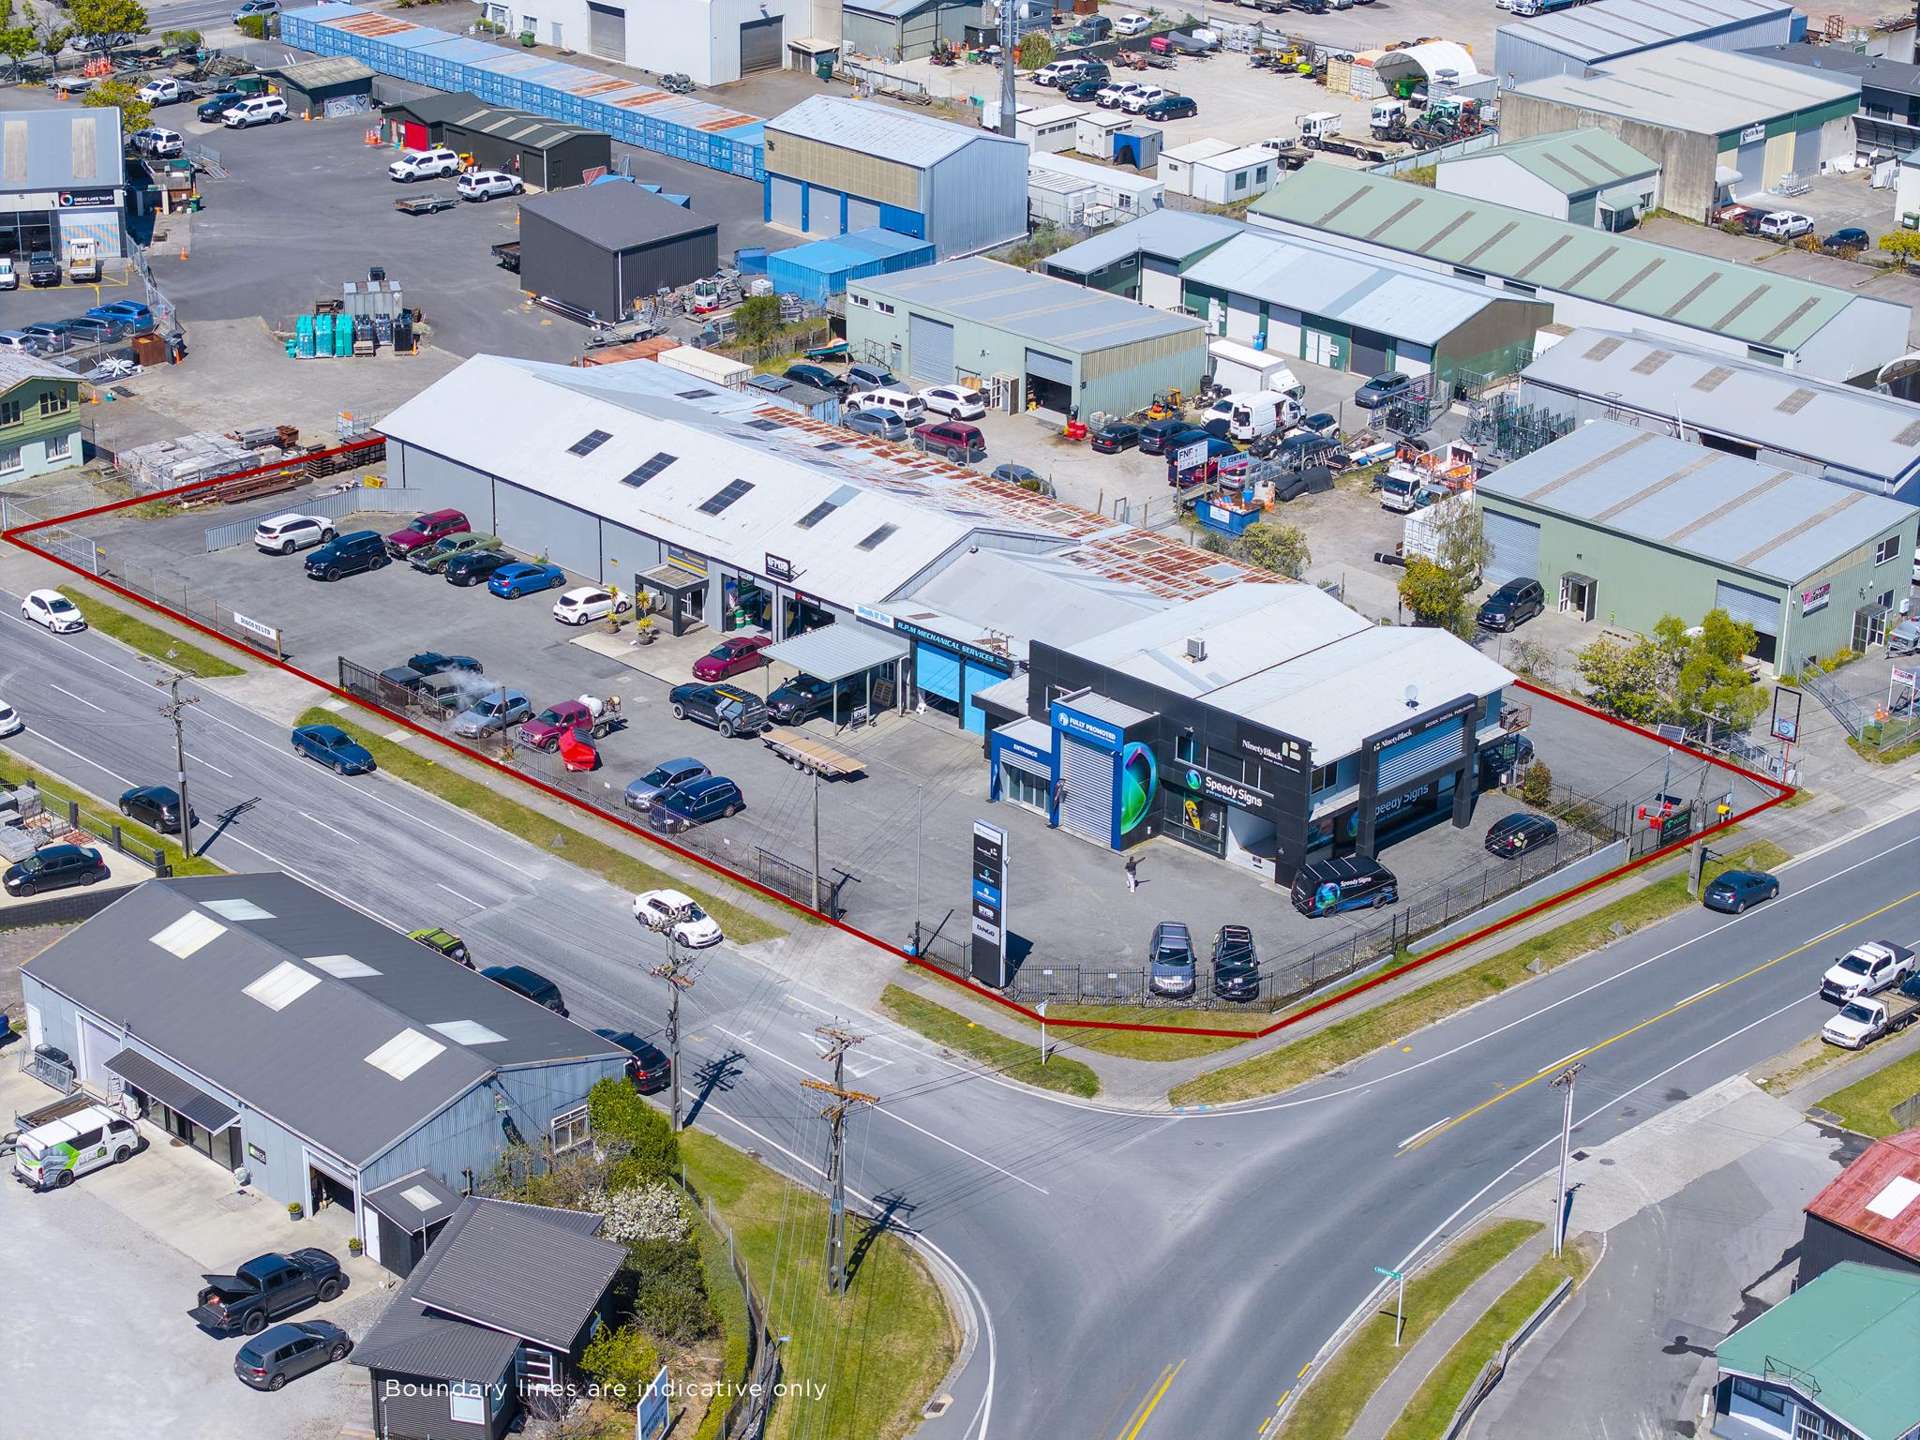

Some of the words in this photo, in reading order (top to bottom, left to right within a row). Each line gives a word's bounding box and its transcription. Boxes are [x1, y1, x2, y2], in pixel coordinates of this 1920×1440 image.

[917, 629, 961, 651] MECHANICAL
[961, 645, 995, 662] SERVICES
[1069, 717, 1085, 729] FULLY
[1086, 723, 1116, 741] PROMOTED
[1381, 729, 1413, 746] NinetyBlack
[1013, 743, 1038, 758] ENTRANCE
[1241, 739, 1283, 761] NinetyBlack
[1205, 776, 1238, 799] Speedy
[1238, 789, 1263, 807] Signs
[1375, 797, 1403, 816] peedy
[1403, 784, 1429, 803] Signs
[1340, 879, 1358, 887] Speedy
[1358, 877, 1372, 885] Signs
